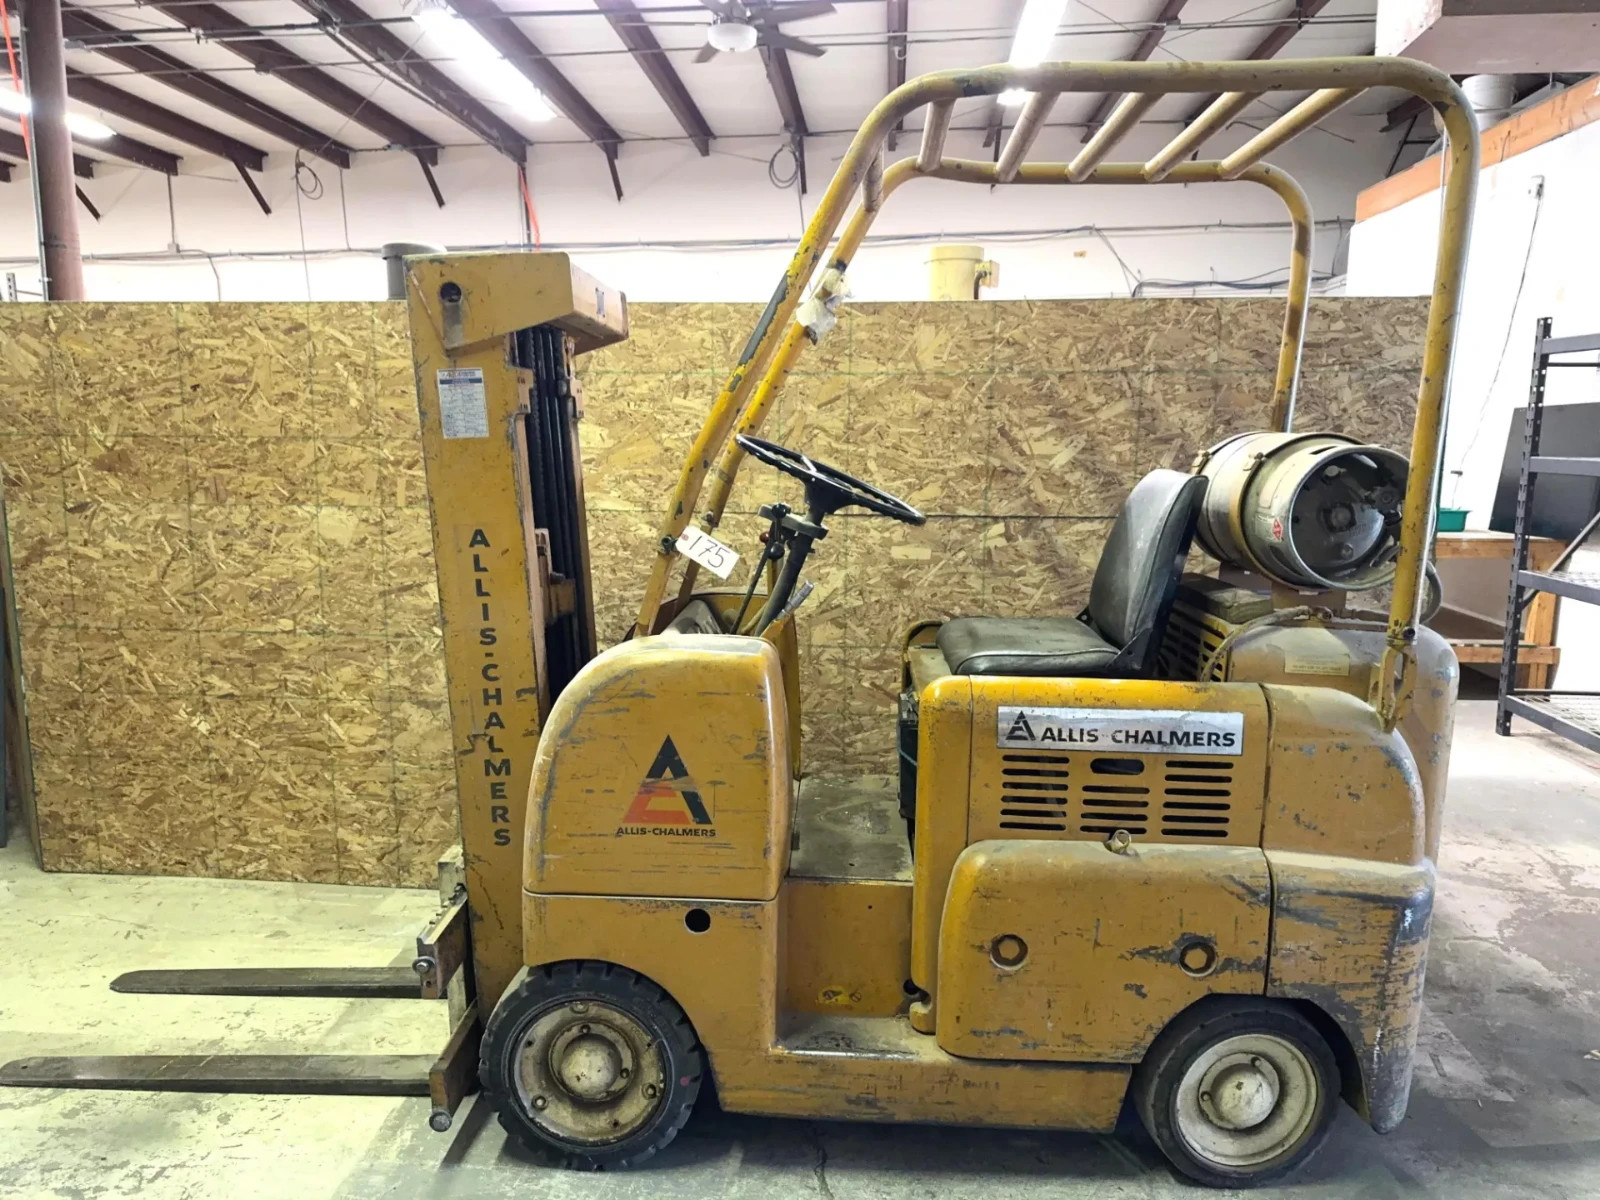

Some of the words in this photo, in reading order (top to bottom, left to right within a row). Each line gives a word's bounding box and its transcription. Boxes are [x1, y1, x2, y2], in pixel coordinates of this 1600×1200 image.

[688, 535, 731, 568] 175
[469, 529, 511, 846] ALLIS-CHALMERS
[1040, 727, 1099, 743] ALLIS
[1111, 729, 1236, 747] CHALMERS
[616, 827, 716, 837] ALLIS-CHALMERS
